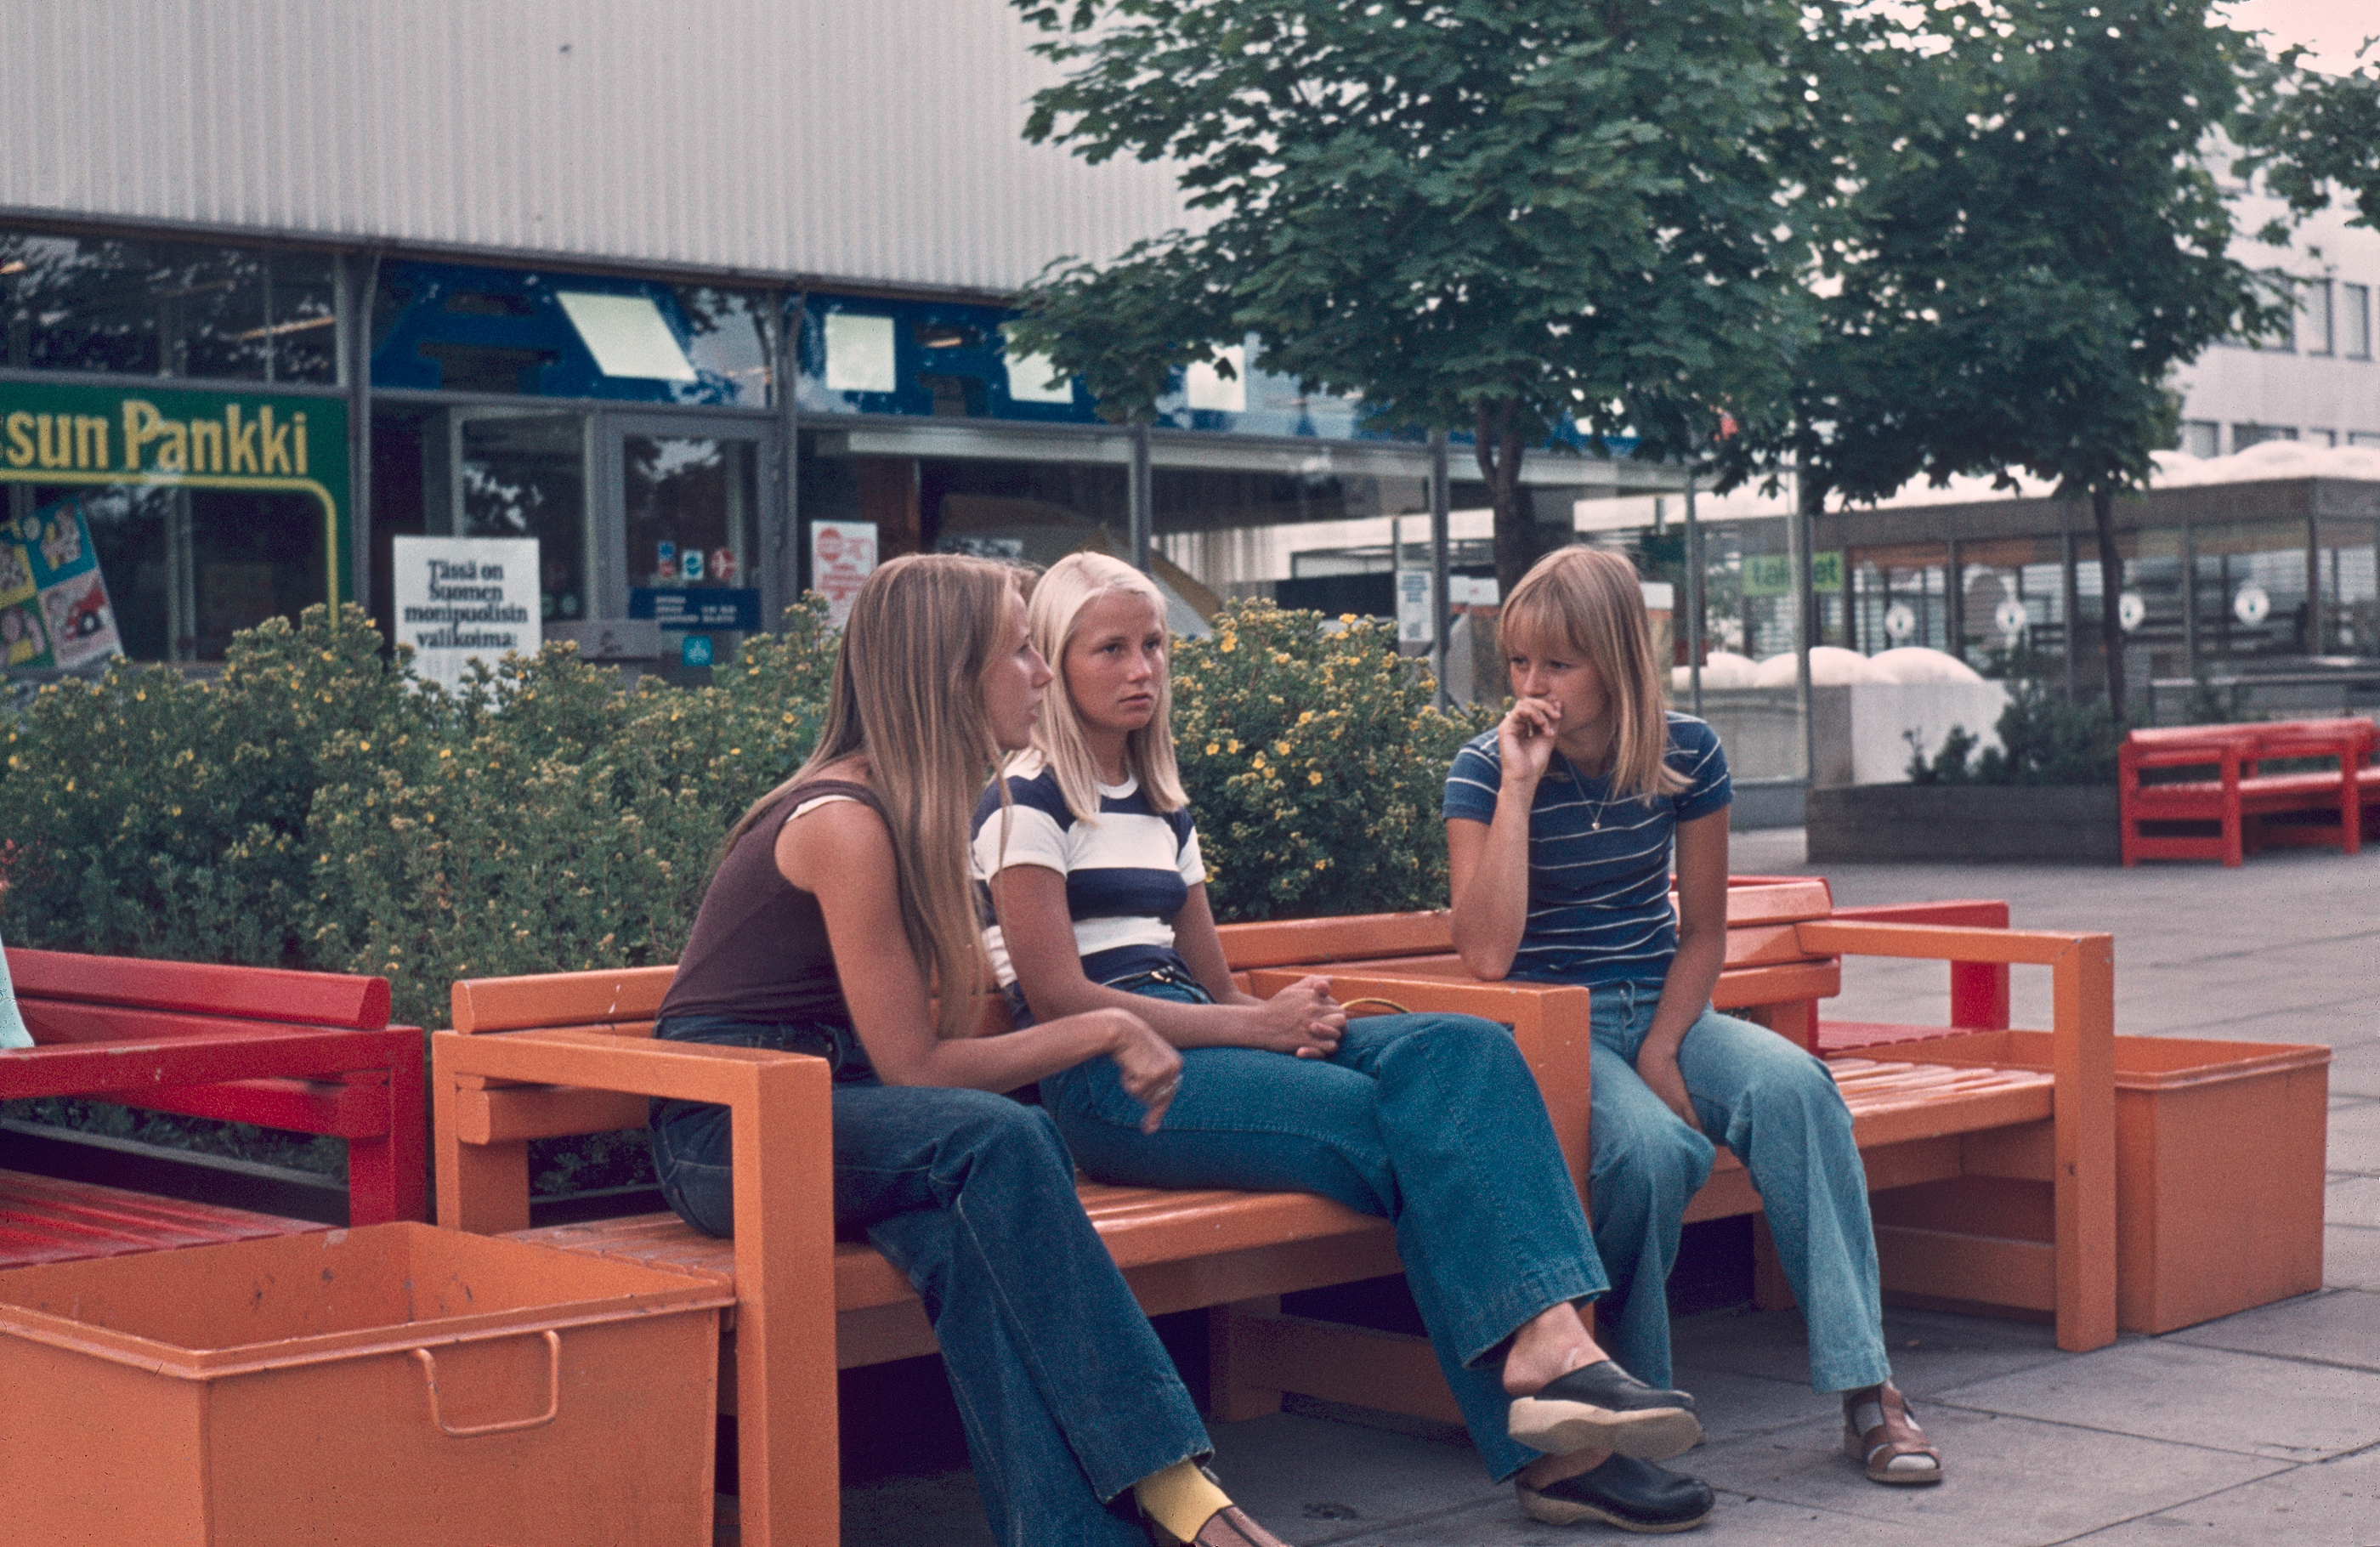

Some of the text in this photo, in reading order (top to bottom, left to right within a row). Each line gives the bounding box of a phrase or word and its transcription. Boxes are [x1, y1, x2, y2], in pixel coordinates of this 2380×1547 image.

[122, 399, 309, 475] Pankki
[428, 559, 504, 581] Tässä on
[428, 581, 504, 602] Suomen
[404, 603, 528, 632] monipuolisin
